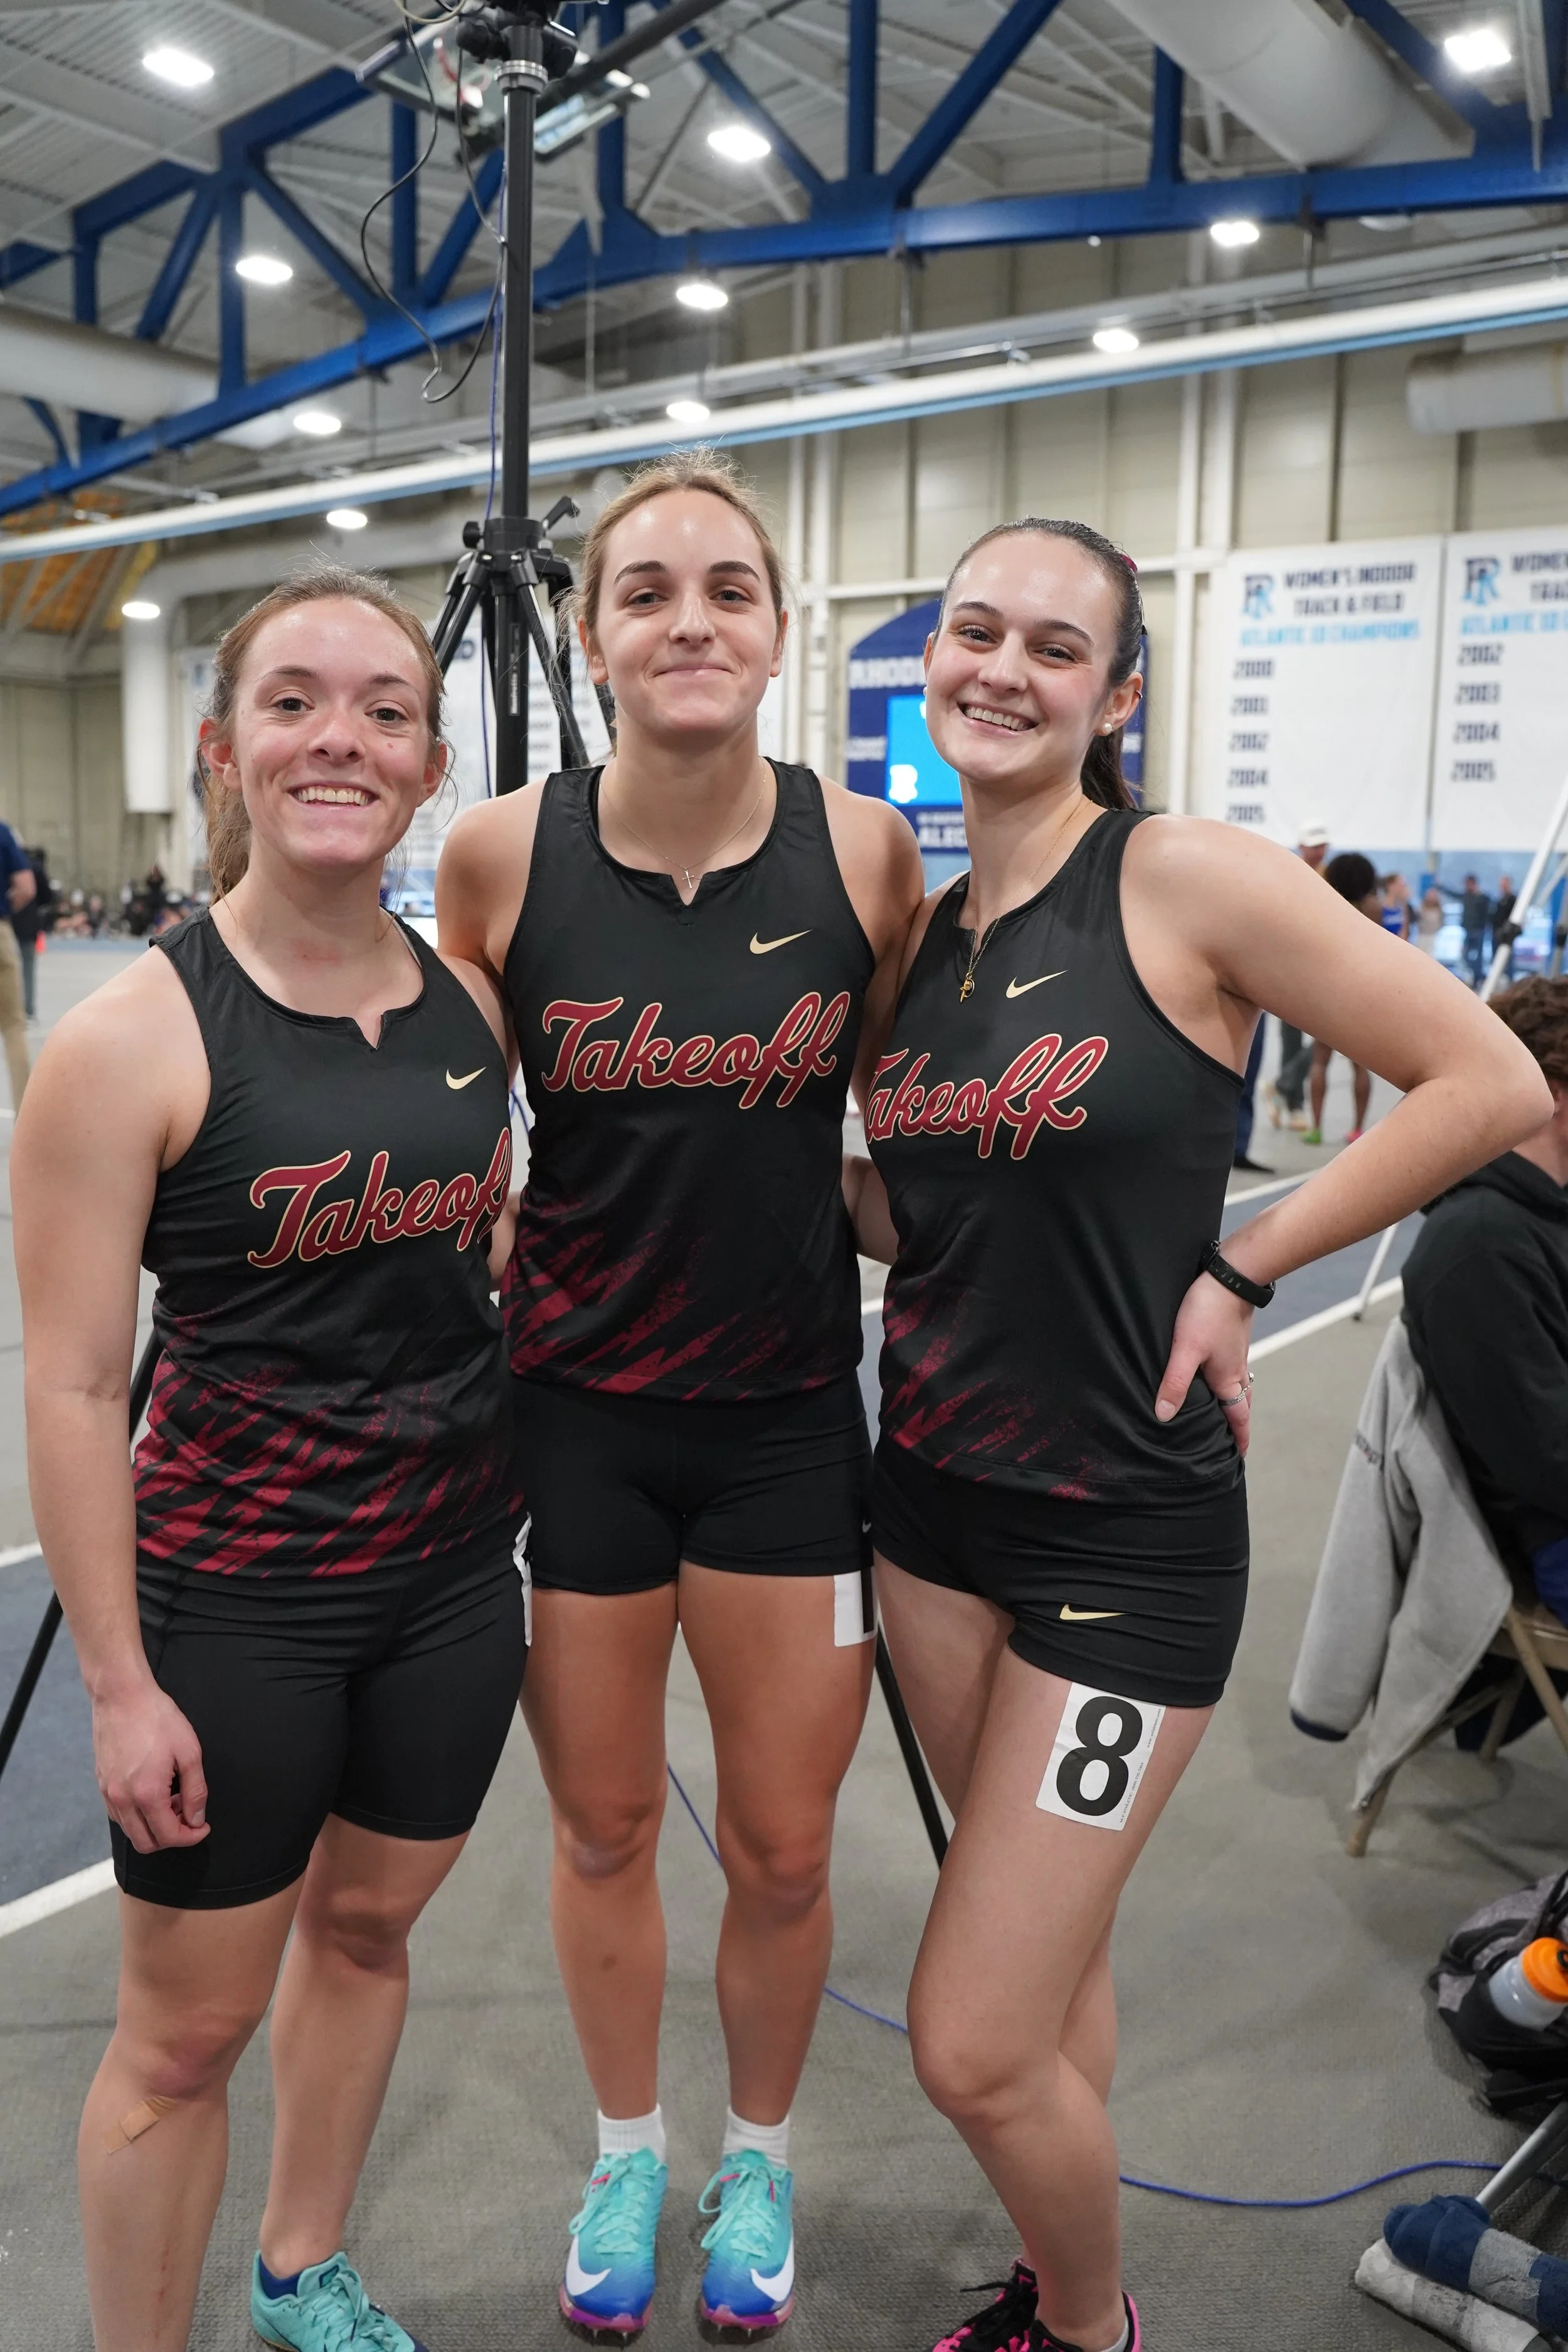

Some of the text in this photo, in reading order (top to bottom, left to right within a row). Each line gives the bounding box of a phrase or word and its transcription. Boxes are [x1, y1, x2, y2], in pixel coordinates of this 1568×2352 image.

[1512, 550, 1568, 573] WOME
[1294, 597, 1339, 616] TRACK
[1362, 591, 1404, 612] FIELD
[541, 991, 850, 1109] Takeoff
[1056, 1696, 1143, 1816] 8
